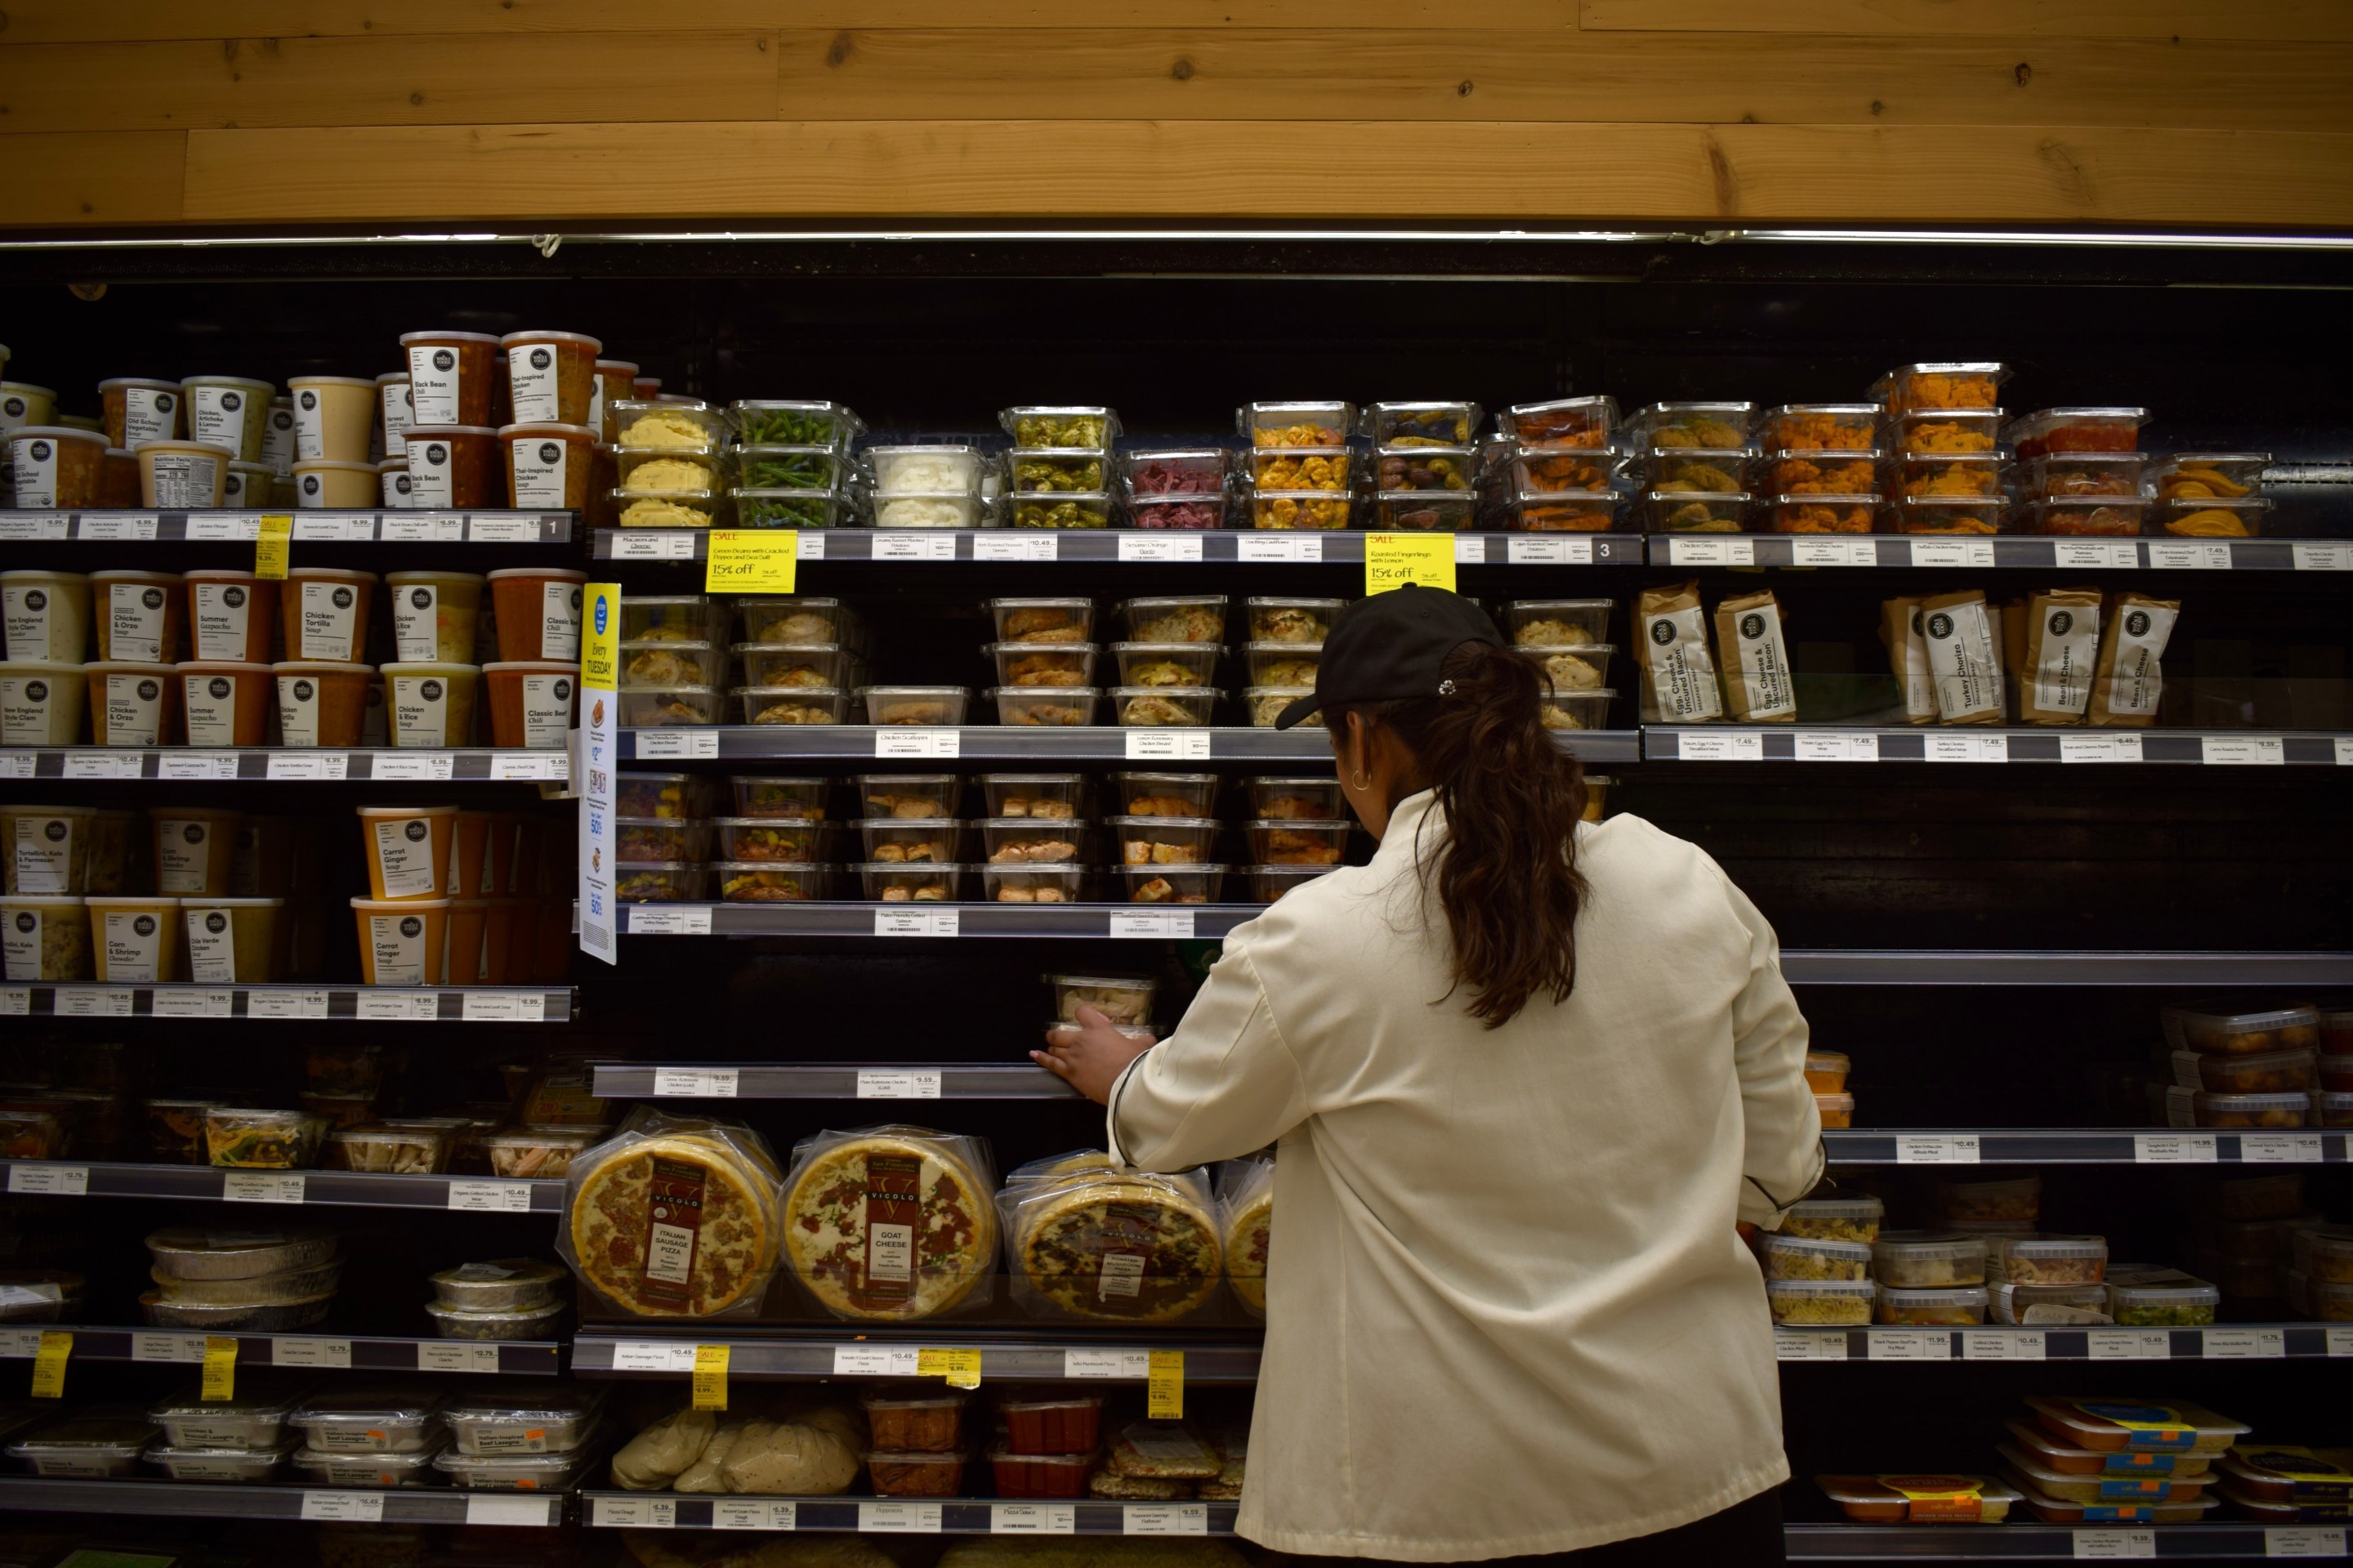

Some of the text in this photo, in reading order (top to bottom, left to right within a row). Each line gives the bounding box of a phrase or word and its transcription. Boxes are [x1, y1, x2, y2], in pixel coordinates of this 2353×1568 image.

[512, 375, 545, 383] Thai-Inspired
[550, 522, 556, 534] 1
[714, 532, 739, 540] SALE
[1601, 543, 1610, 556] 3
[712, 564, 755, 574] 15% off
[1371, 567, 1413, 578] 15% off
[592, 643, 606, 659] Every
[587, 660, 611, 675] TUESDAY
[2061, 646, 2069, 677] Cheese
[2136, 649, 2149, 679] Cheese
[1669, 663, 1680, 694] Cheese
[1758, 658, 1769, 689] Cheese
[1954, 644, 1971, 708] Turkey Chorizo
[1681, 677, 1692, 714] Uncured
[1770, 672, 1779, 708] Uncured
[1694, 684, 1702, 711] BREAKFAST
[591, 820, 599, 834] 50
[655, 1195, 698, 1207] VICOLO
[659, 1231, 685, 1240] ITALIAN
[655, 1239, 688, 1249] SAUSAGE
[661, 1247, 681, 1255] PIZZA
